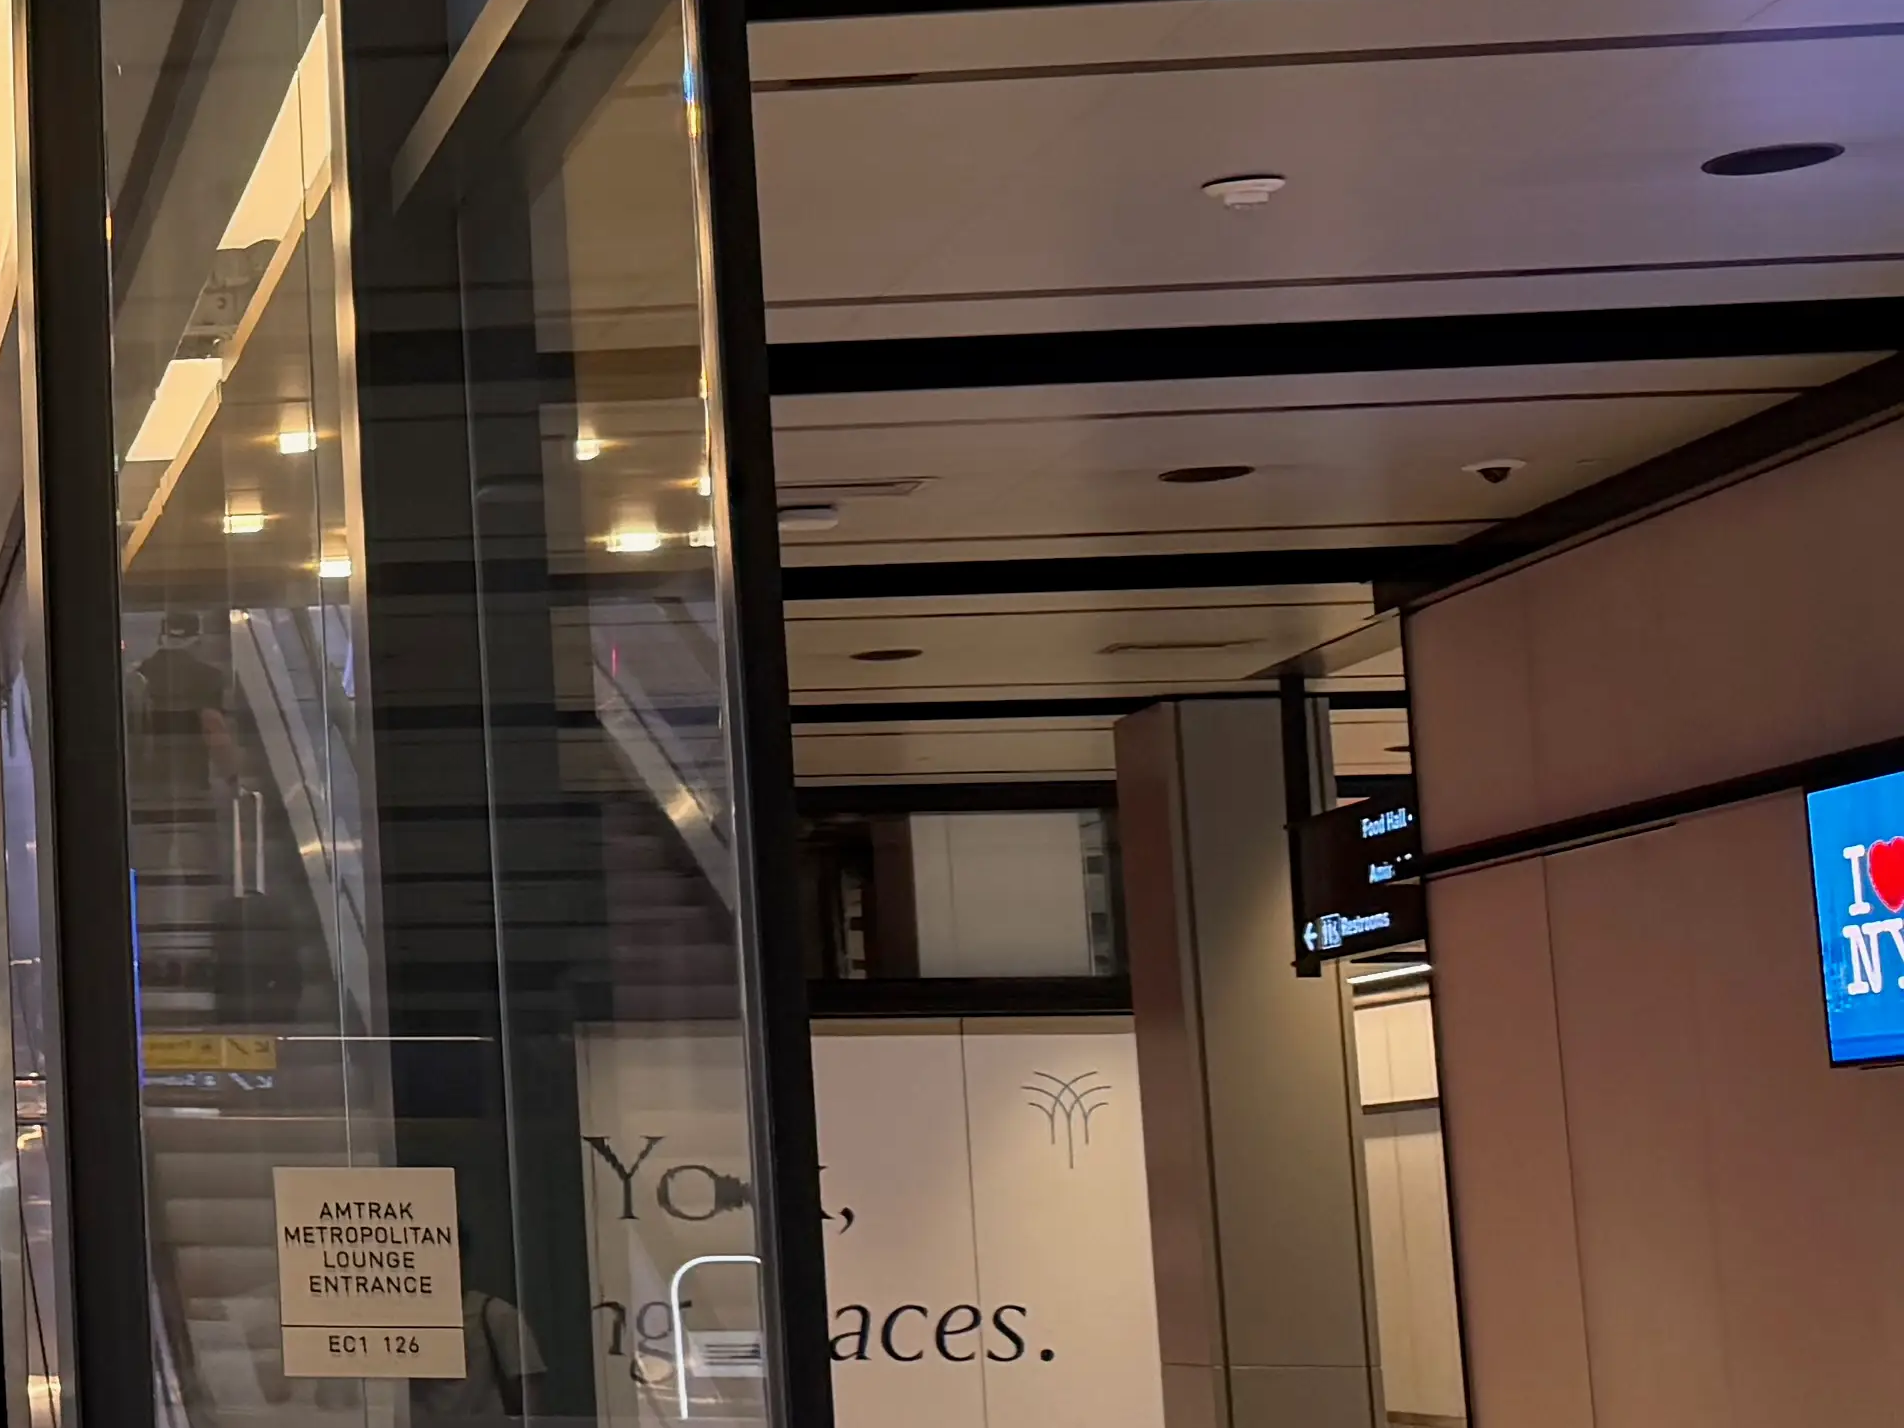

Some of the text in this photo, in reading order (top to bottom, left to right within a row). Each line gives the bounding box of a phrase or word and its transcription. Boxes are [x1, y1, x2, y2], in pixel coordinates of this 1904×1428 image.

[1843, 844, 1871, 916] I
[319, 1202, 414, 1220] AMTRAK
[284, 1226, 452, 1245] METROPOLITAN
[324, 1251, 415, 1269] LOUNGE
[309, 1275, 433, 1295] ENTRANCE
[329, 1335, 420, 1353] EC1 126
